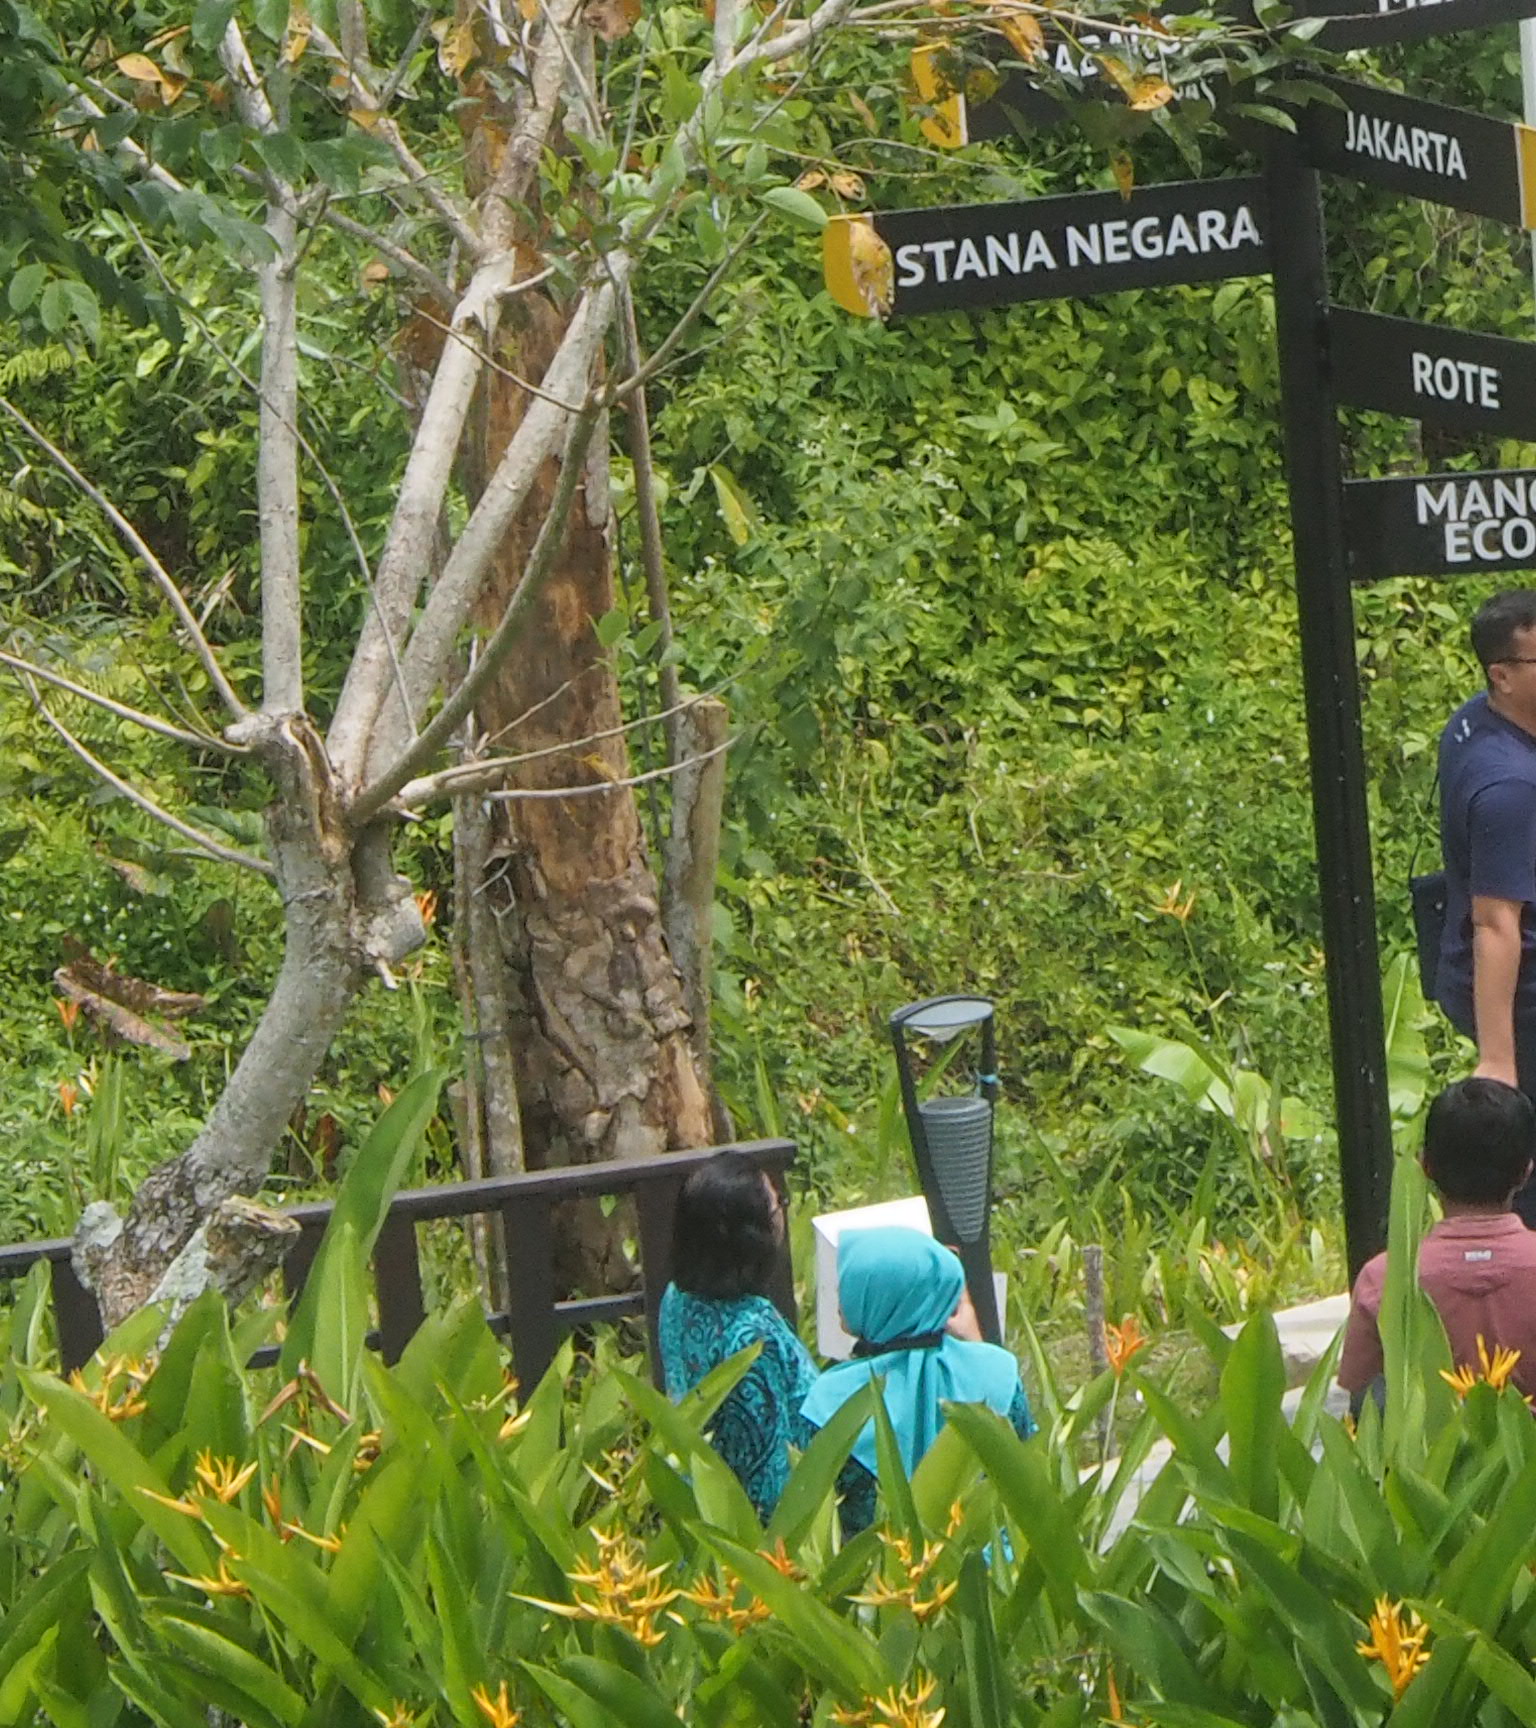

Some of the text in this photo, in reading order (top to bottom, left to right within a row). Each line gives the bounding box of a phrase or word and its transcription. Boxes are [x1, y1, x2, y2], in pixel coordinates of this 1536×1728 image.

[1344, 110, 1467, 181] JAKARTA
[1065, 205, 1262, 267] NEGARA
[1411, 351, 1500, 409] ROTE
